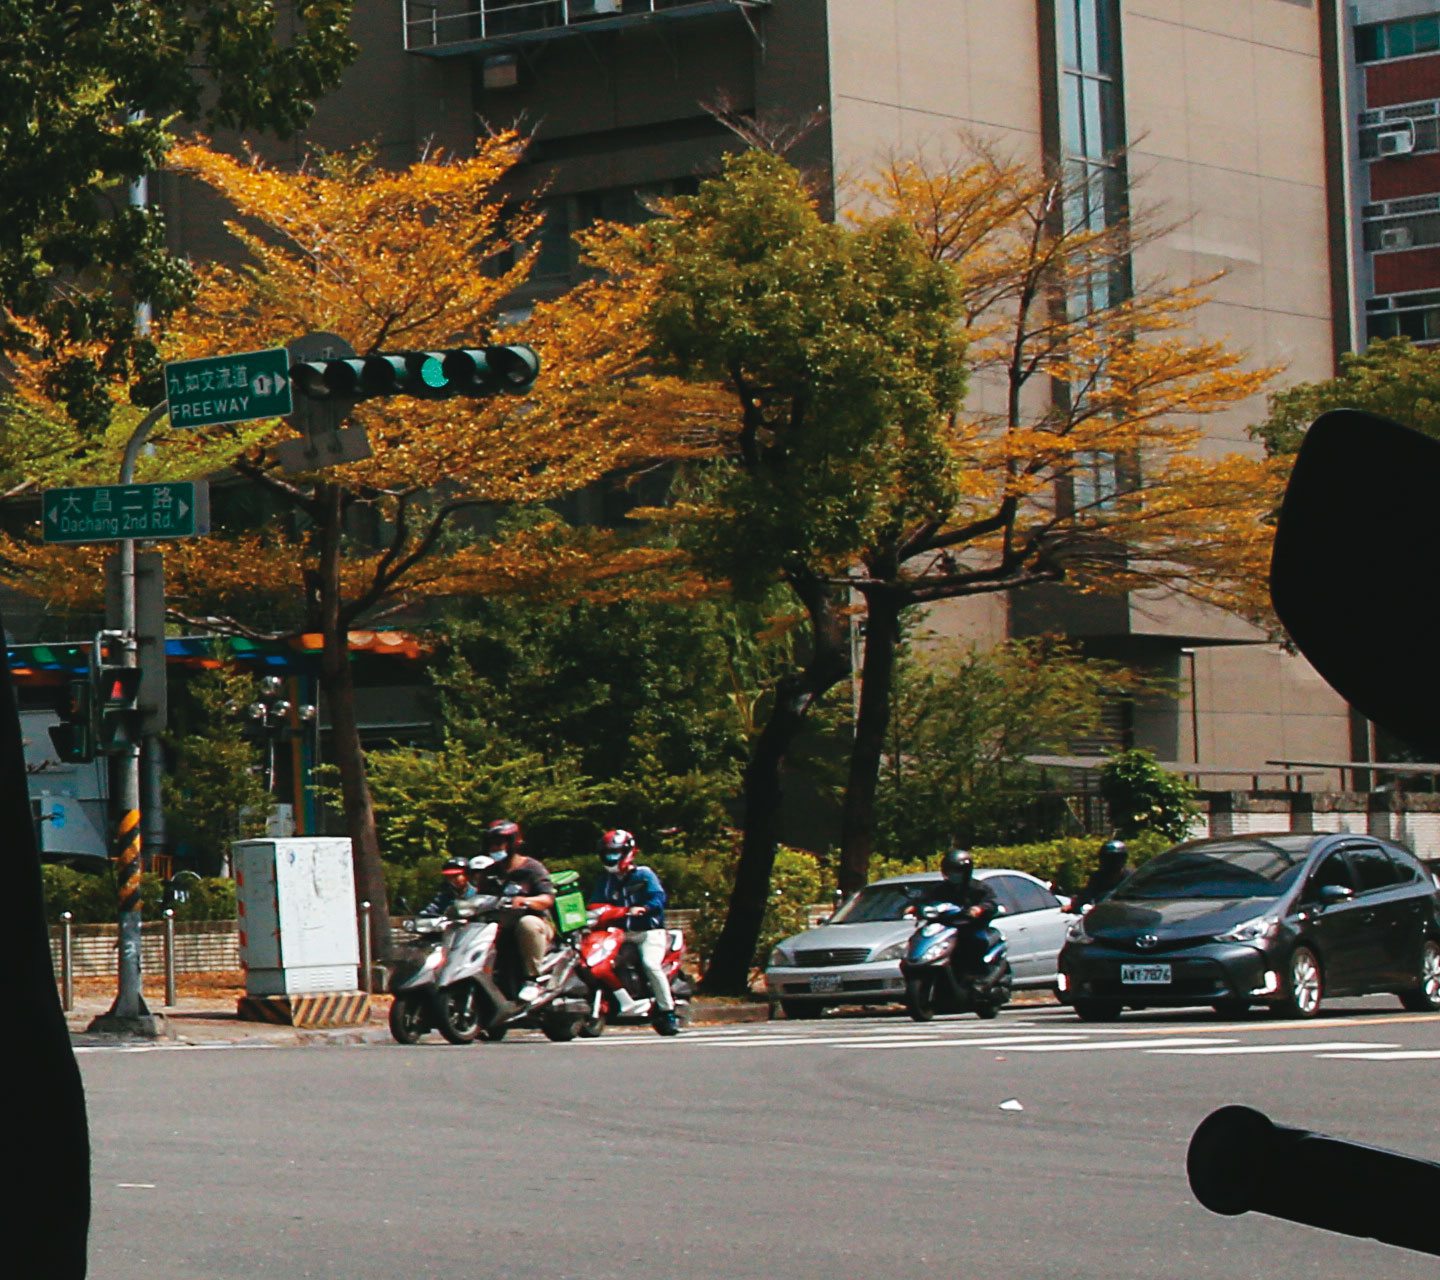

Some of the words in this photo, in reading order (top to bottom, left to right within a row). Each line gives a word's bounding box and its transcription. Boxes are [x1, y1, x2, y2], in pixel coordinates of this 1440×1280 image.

[170, 365, 248, 395] 九如交流道
[171, 396, 249, 419] FREEWAY
[62, 487, 173, 513] 大昌二路
[61, 518, 118, 534] Dachang
[123, 514, 147, 530] 2nd
[152, 512, 175, 528] Rd.
